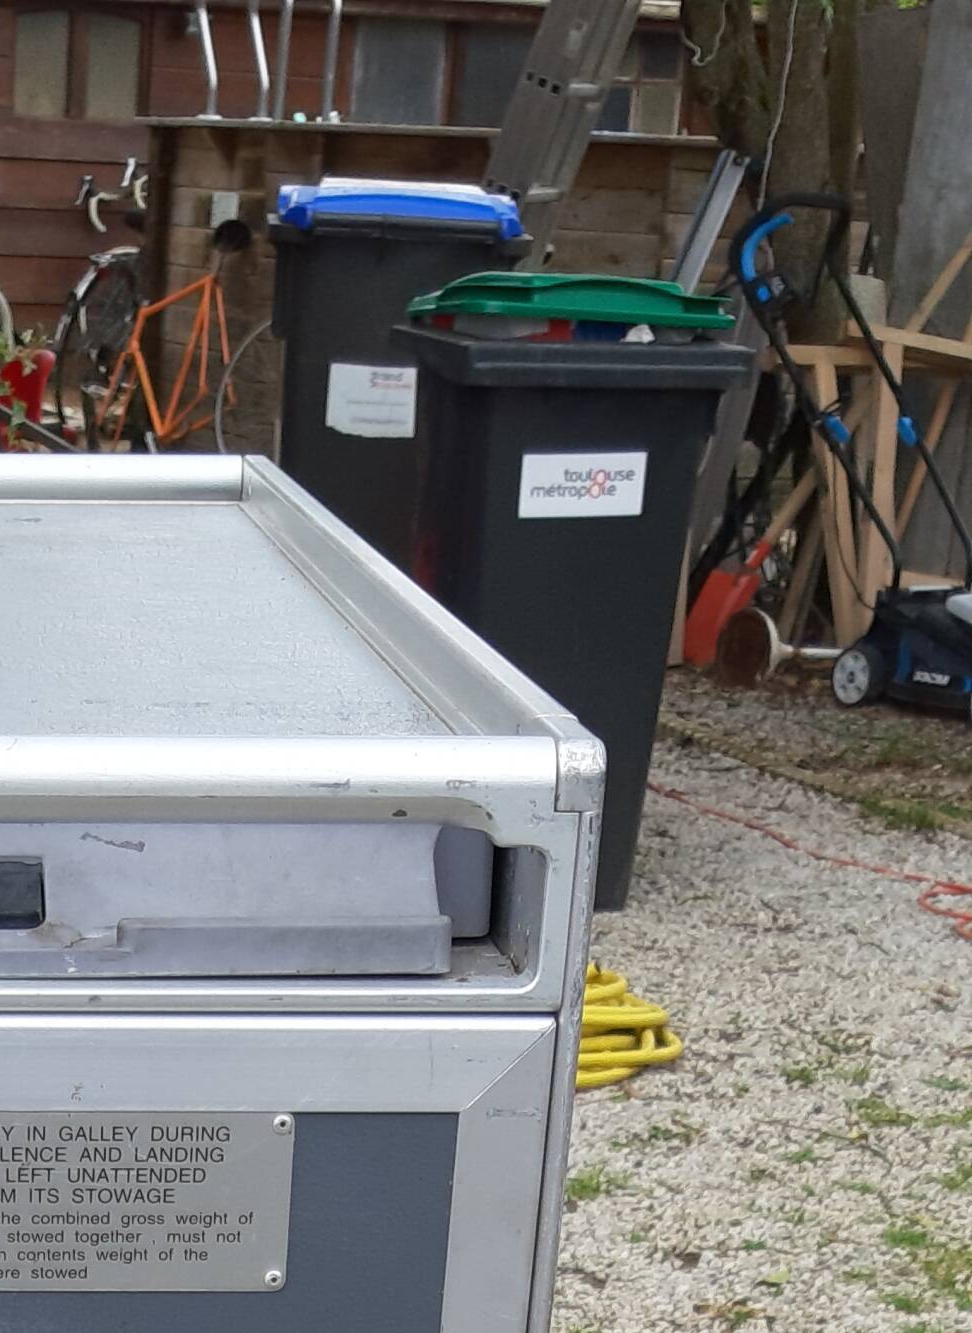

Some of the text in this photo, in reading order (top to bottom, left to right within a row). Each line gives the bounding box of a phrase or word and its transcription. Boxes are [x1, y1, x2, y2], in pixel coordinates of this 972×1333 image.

[564, 468, 636, 485] toulouse
[530, 482, 617, 501] métropole
[27, 1125, 47, 1142] IN
[58, 1125, 139, 1143] GALLEY
[150, 1125, 231, 1143] DURING
[78, 1146, 123, 1163] AND
[134, 1146, 225, 1164] LANDING
[5, 1166, 56, 1184] LEFT
[67, 1167, 207, 1184] UNATTENDED
[29, 1187, 60, 1204] ITS
[71, 1187, 176, 1205] STOWAGE
[31, 1210, 111, 1225] combined
[120, 1214, 165, 1229] gross
[175, 1211, 228, 1229] weight
[238, 1211, 254, 1225] of
[6, 1229, 65, 1244] stowed
[74, 1229, 143, 1247] together
[166, 1229, 206, 1244] must
[216, 1230, 241, 1244] not
[16, 1248, 86, 1263] contents
[95, 1247, 149, 1265] weight
[158, 1247, 174, 1262] of
[183, 1247, 209, 1262] the
[30, 1265, 88, 1280] stowed
